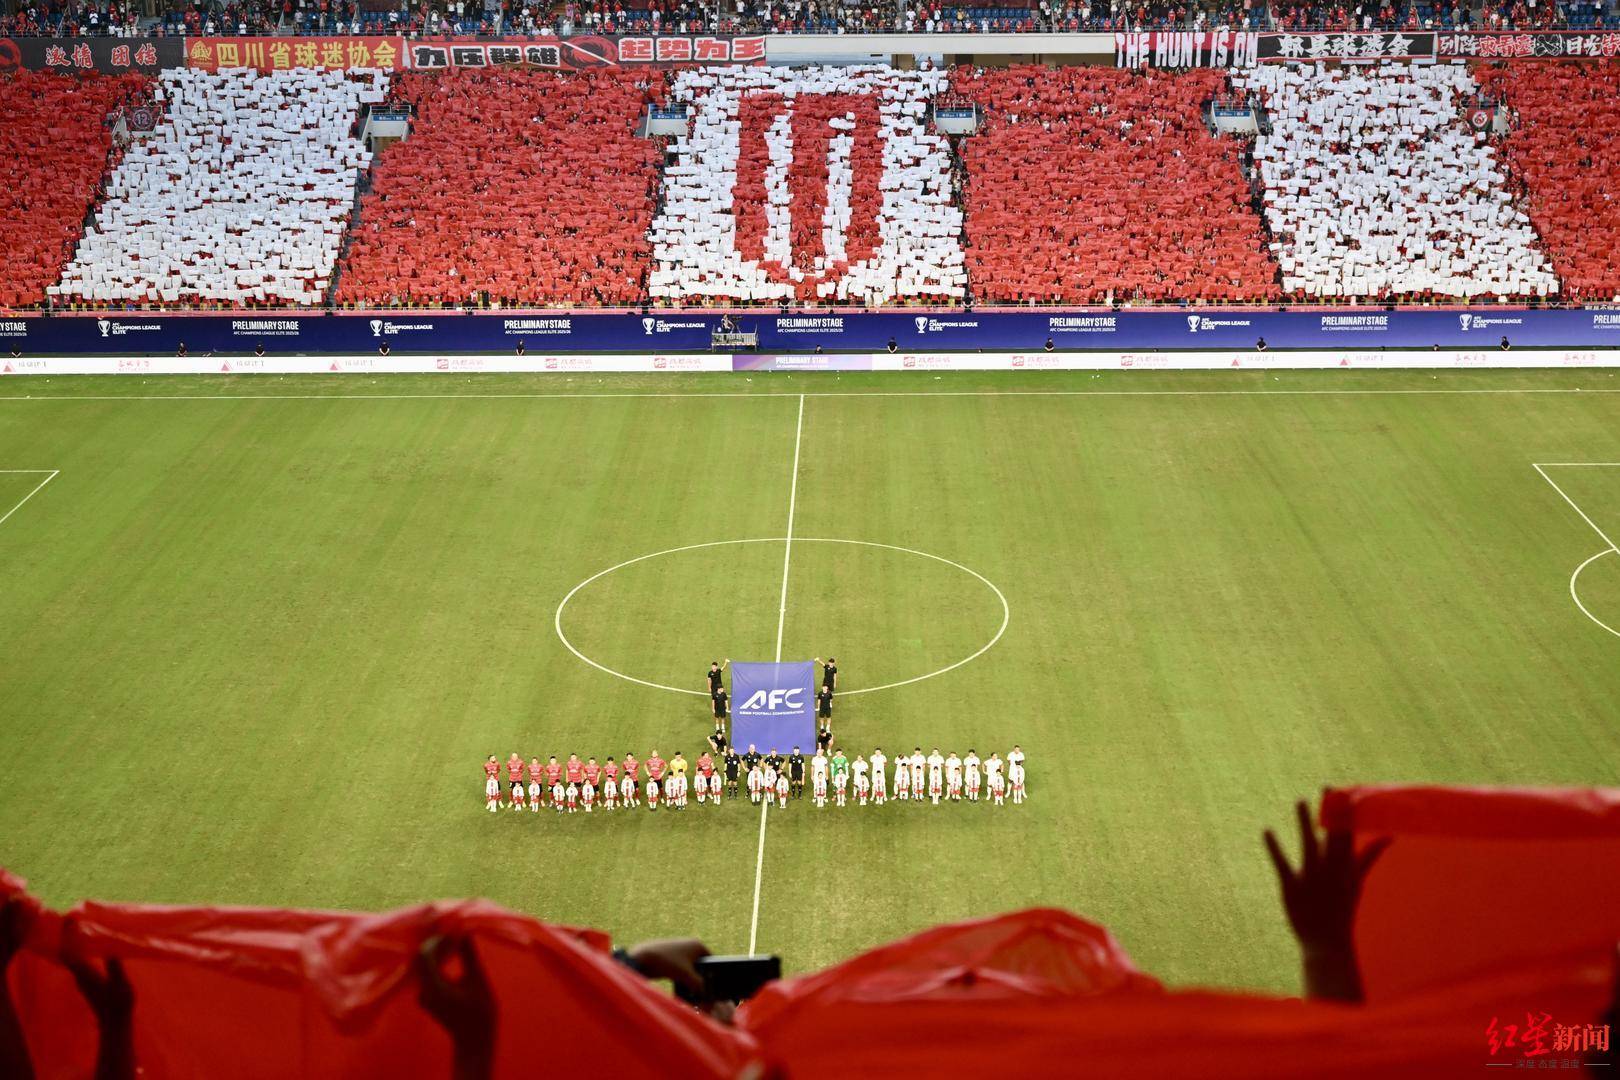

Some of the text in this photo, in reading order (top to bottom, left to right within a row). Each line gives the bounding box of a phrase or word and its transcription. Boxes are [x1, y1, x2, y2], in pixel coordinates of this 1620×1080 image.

[46, 43, 157, 68] 激情 团结
[217, 41, 396, 68] 四川省球迷协会
[619, 36, 764, 60] 起势为王
[1116, 32, 1259, 68] THE HUNT IS ON
[412, 46, 559, 68] 力压群雄
[5, 322, 27, 331] STAGE
[232, 321, 298, 330] PRELIMINARY STAGE
[505, 320, 571, 329] PRELIMINARY STAGE
[777, 318, 843, 327] PRELIMINARY STAGE
[1050, 318, 1116, 326] PRELIMINARY STAGE
[1322, 316, 1388, 325] PRELIMINARY STAGE
[740, 688, 804, 709] AFC
